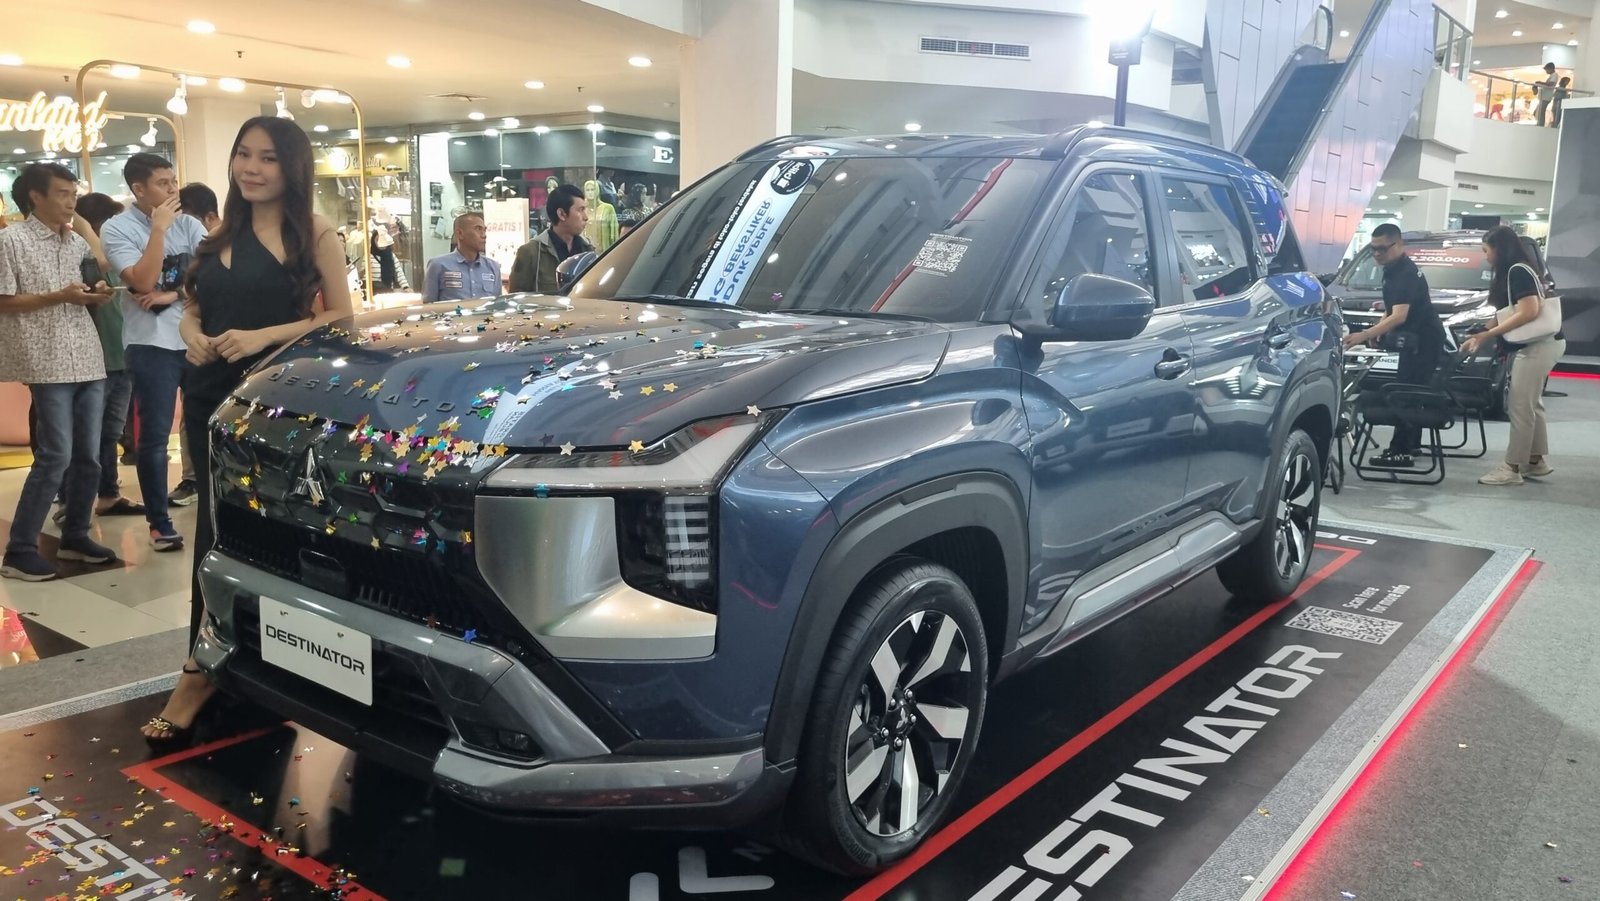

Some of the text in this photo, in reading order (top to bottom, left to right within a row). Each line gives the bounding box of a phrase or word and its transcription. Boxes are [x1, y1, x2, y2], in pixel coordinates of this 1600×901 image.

[652, 146, 674, 164] E
[486, 222, 517, 232] GRATIS
[266, 624, 365, 675] DESTINATOR
